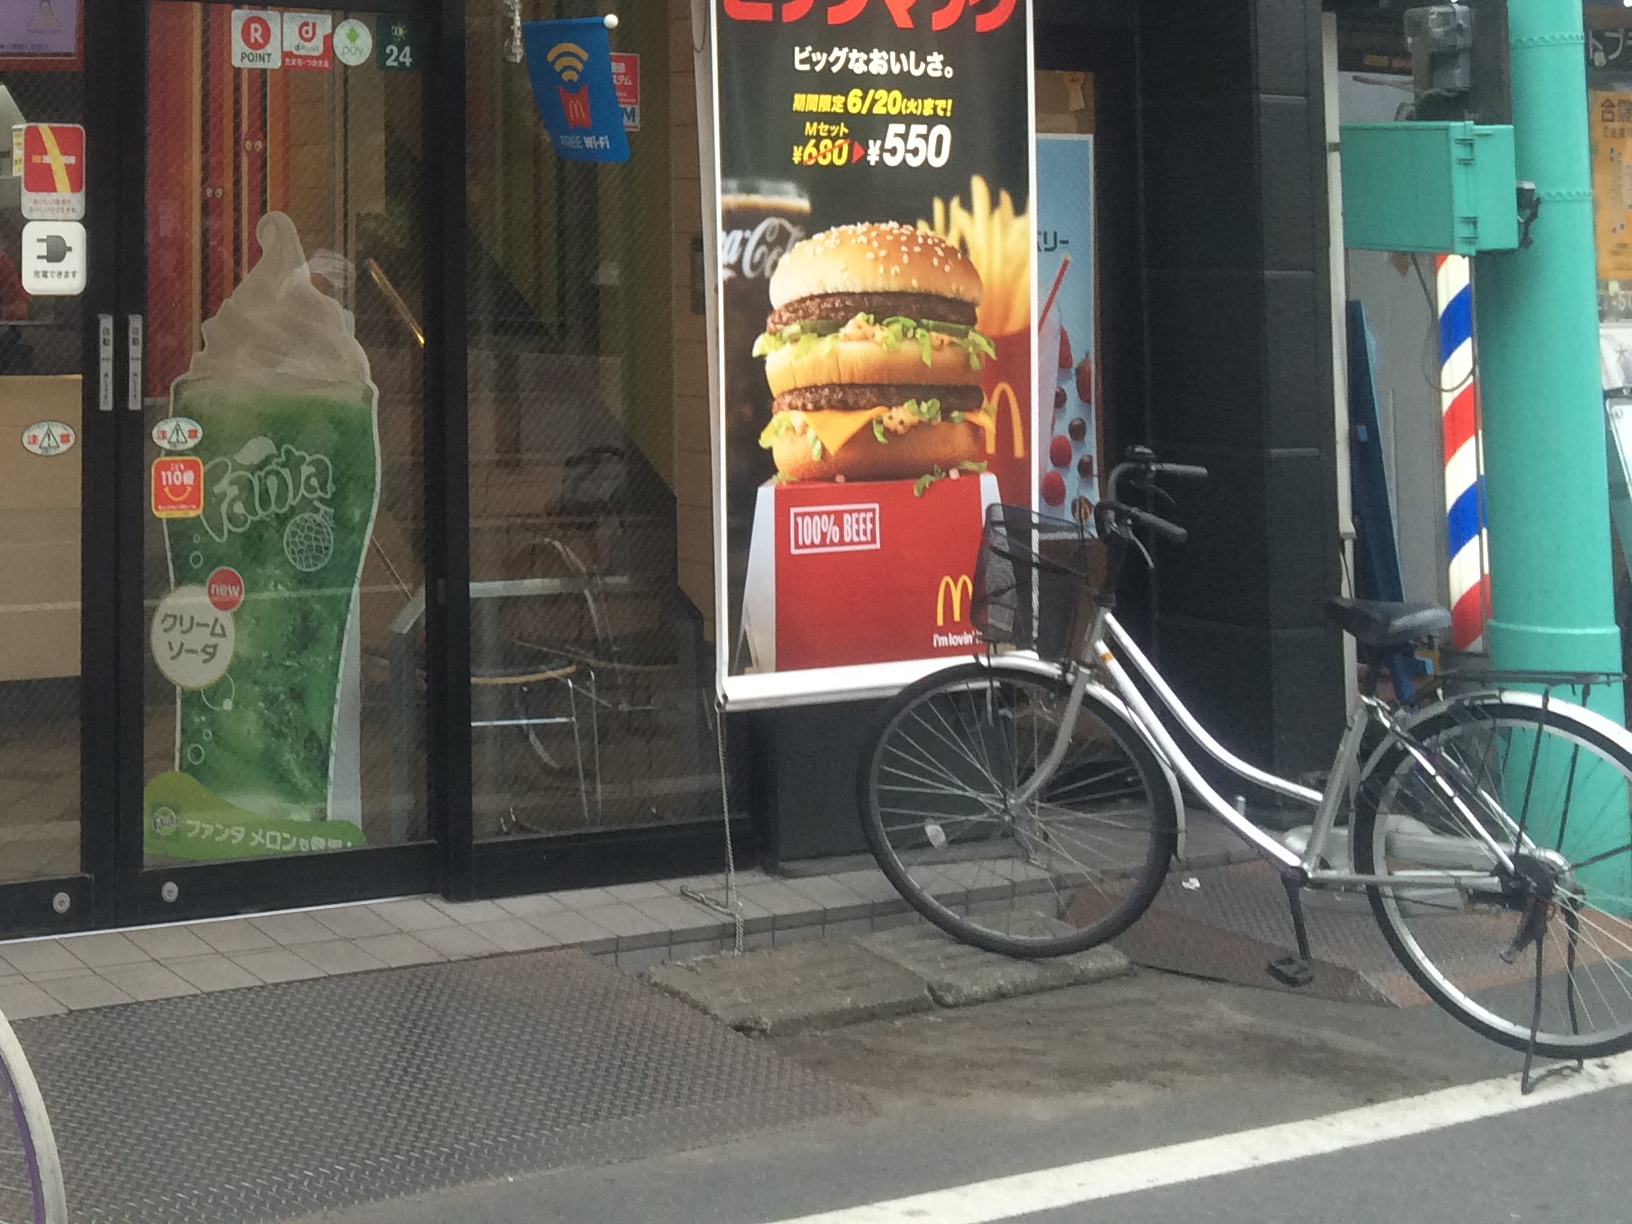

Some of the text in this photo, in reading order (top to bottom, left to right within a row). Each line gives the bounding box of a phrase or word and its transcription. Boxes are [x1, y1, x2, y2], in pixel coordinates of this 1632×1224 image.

[240, 52, 272, 64] POINT
[385, 44, 413, 67] 24
[794, 46, 954, 79] ビッグなおいしさ。
[804, 121, 849, 137] Mセット
[867, 123, 952, 167] ¥550
[796, 511, 874, 547] 100% BEEF
[210, 583, 240, 599] new
[160, 613, 227, 639] クリーム
[167, 642, 219, 665] ソーダ
[186, 818, 246, 844] ファンタ
